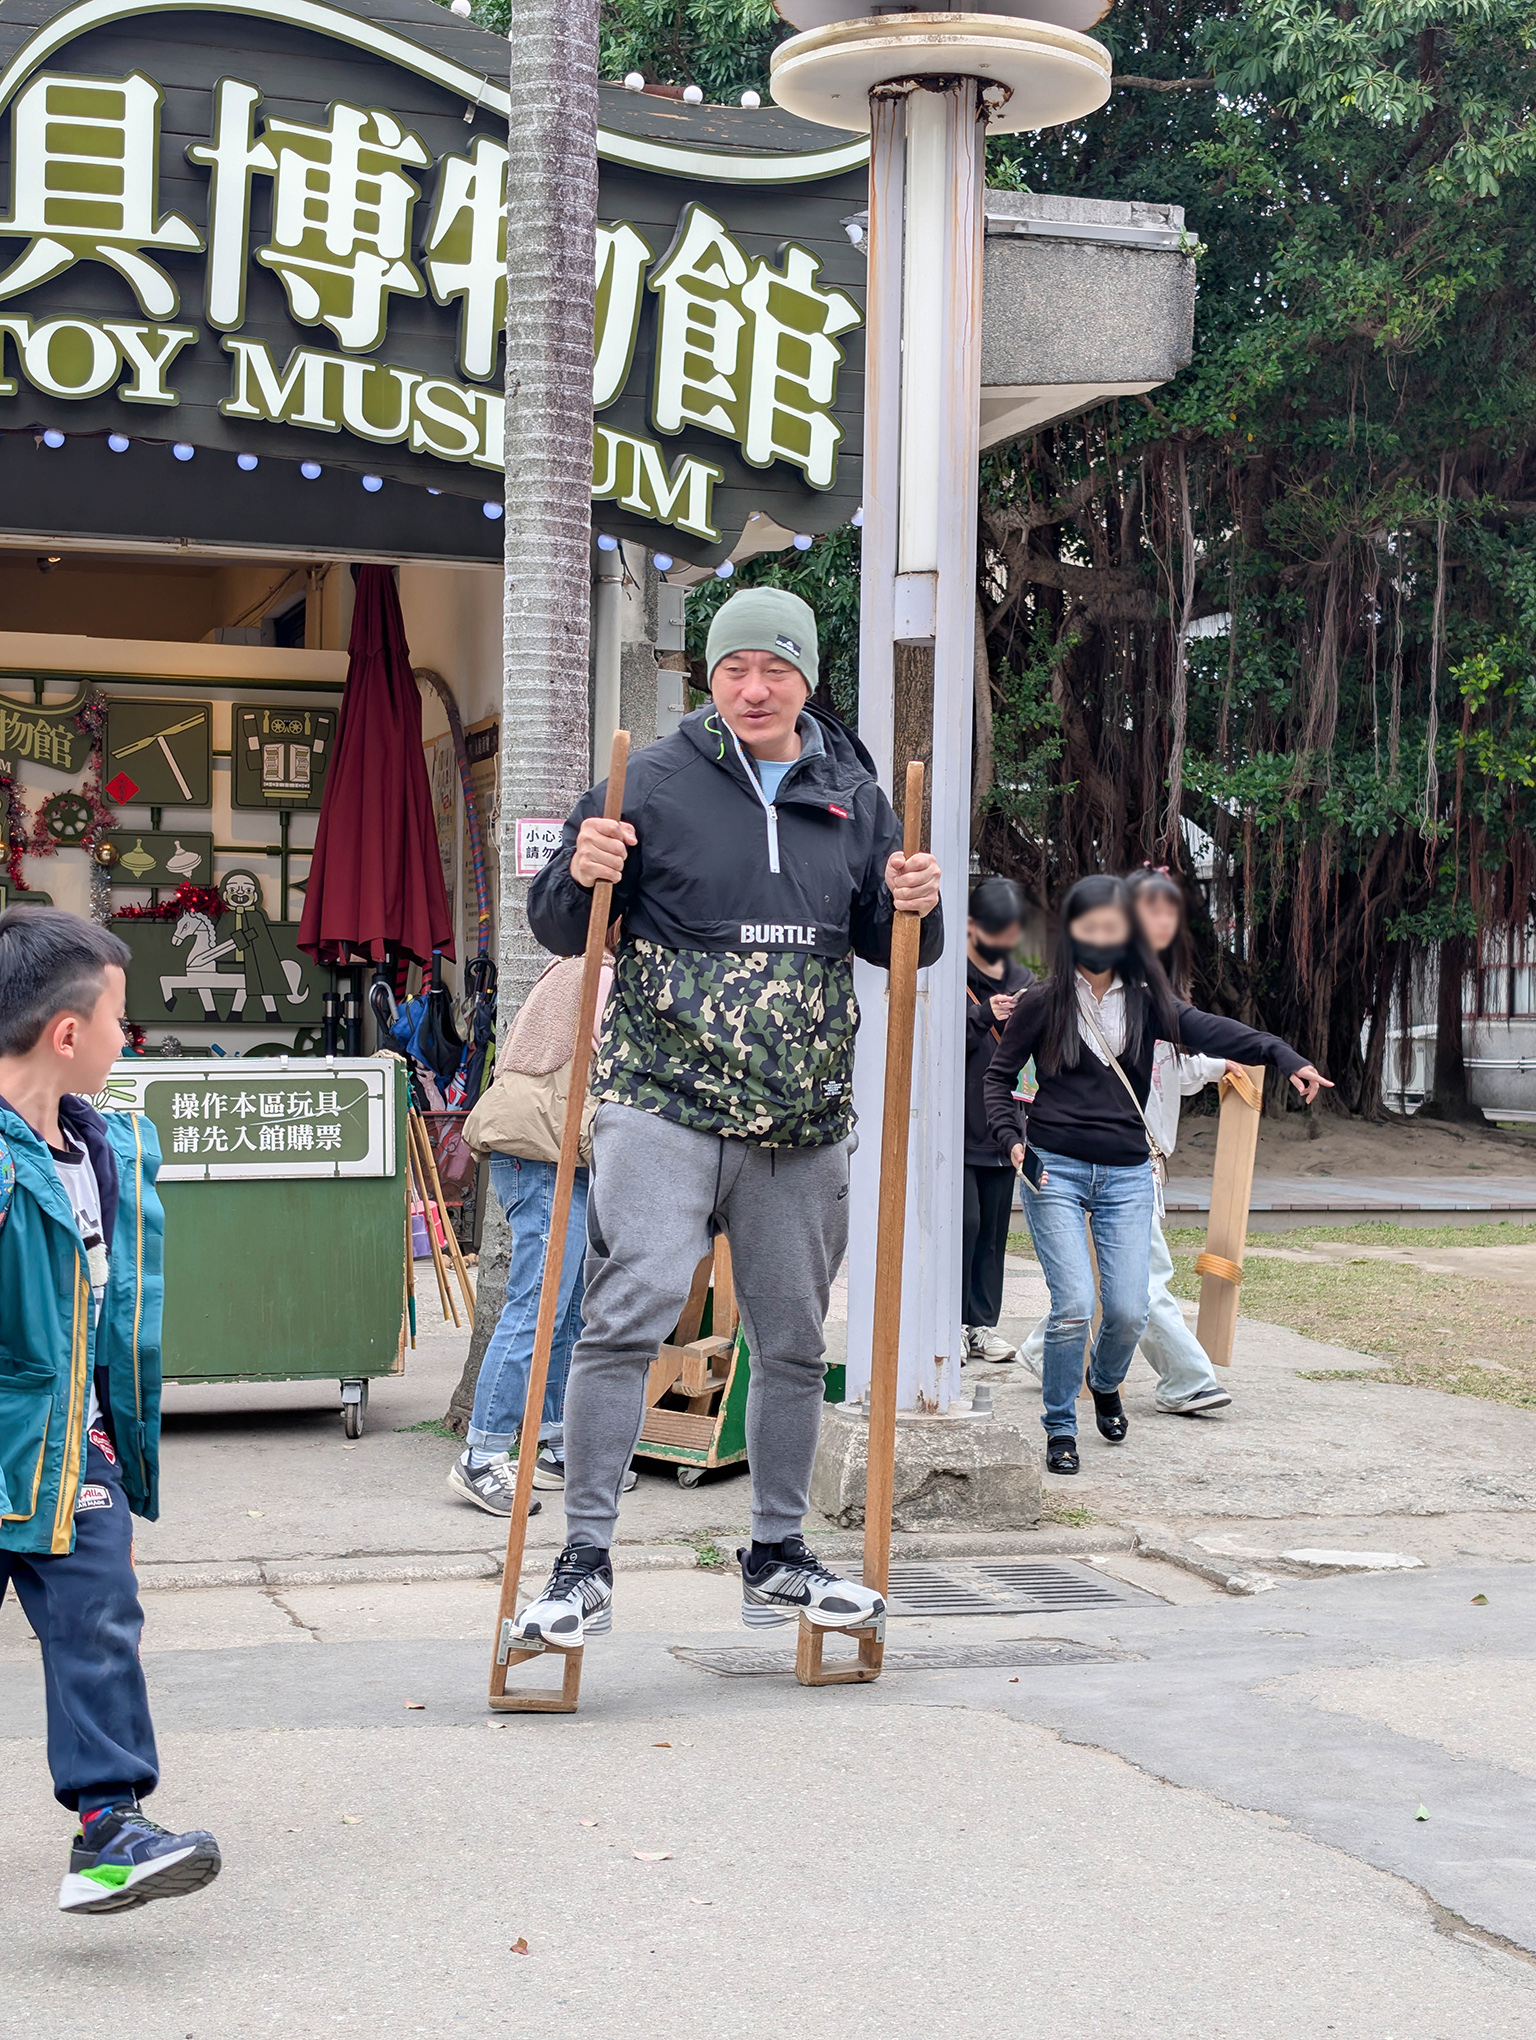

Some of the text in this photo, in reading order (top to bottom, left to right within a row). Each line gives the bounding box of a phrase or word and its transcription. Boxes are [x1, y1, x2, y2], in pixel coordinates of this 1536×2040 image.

[740, 924, 817, 946] BURTLE
[171, 1090, 340, 1120] 操作本區玩具
[172, 1122, 343, 1153] 請先入館購票
